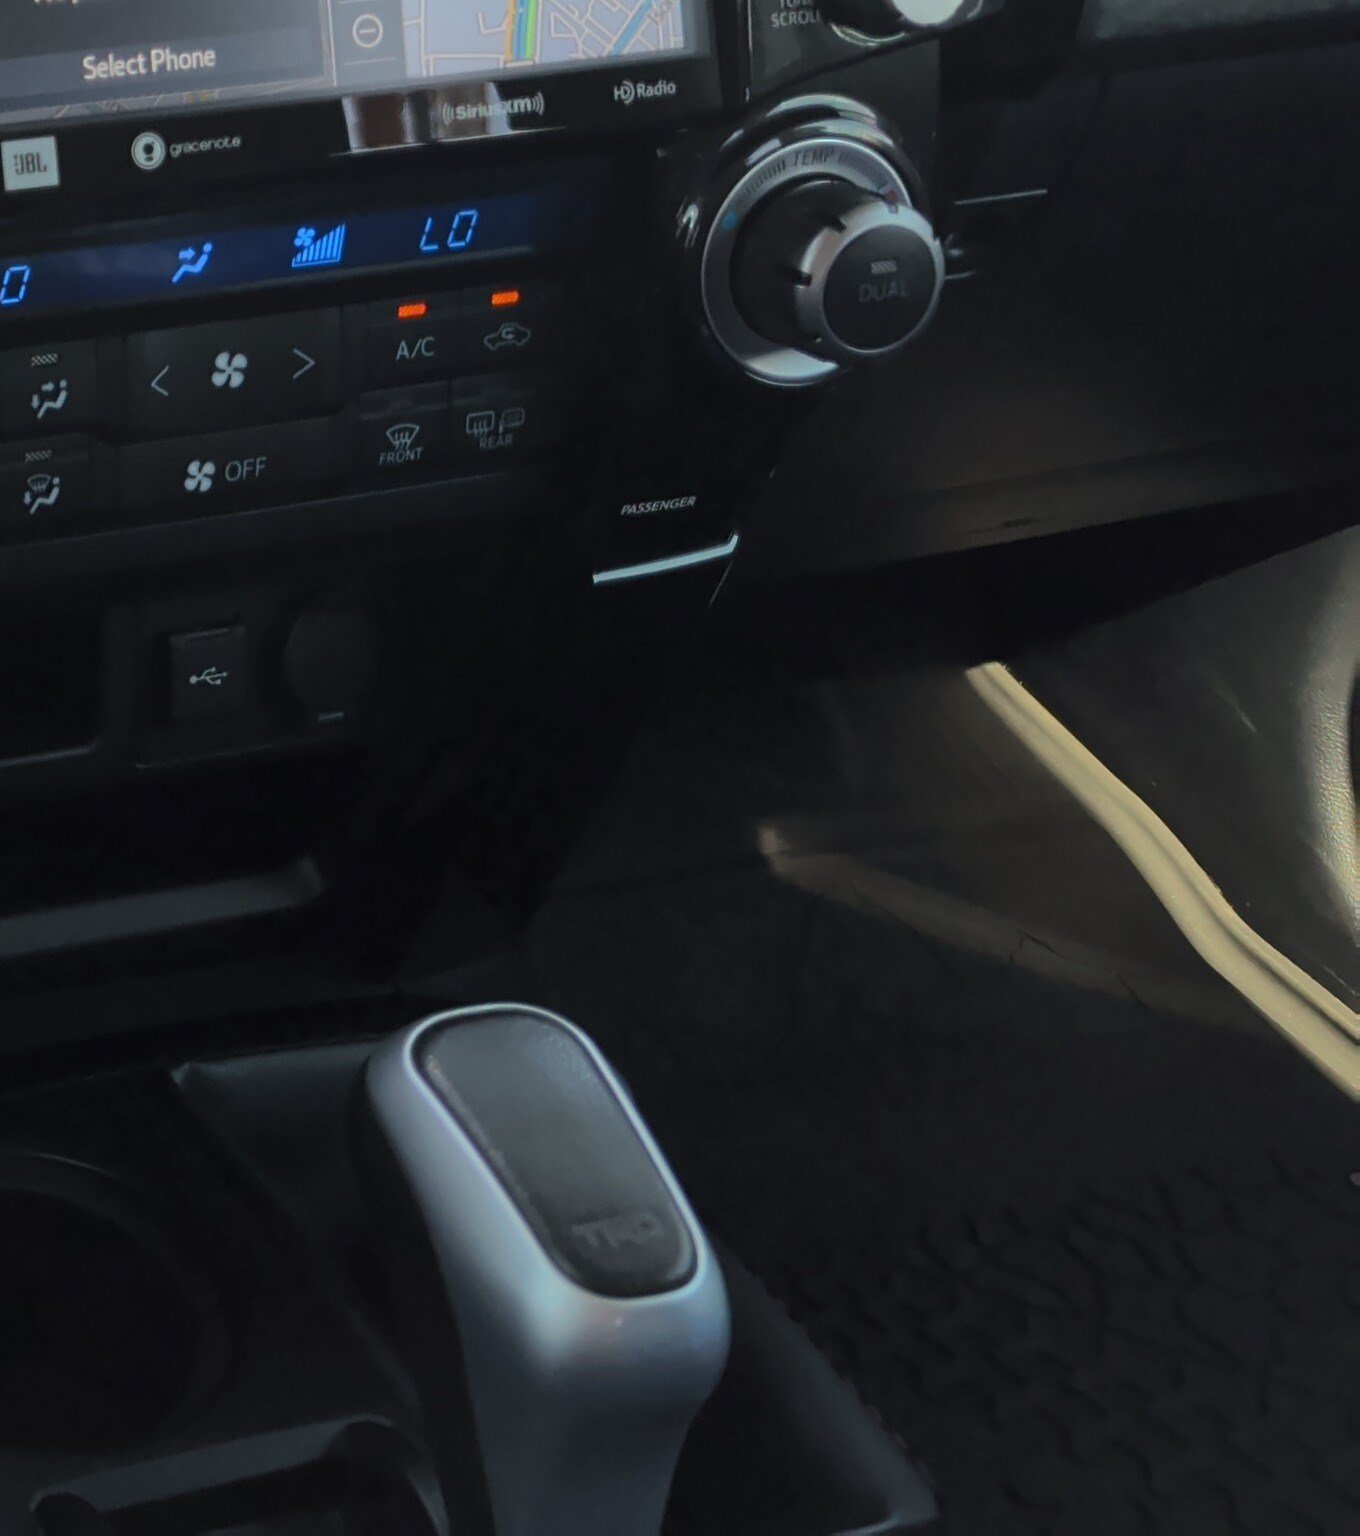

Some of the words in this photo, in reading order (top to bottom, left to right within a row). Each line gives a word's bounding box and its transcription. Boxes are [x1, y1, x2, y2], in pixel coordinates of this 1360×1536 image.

[82, 51, 147, 81] Select
[150, 46, 216, 74] Phone
[636, 81, 676, 98] Radio
[169, 133, 242, 157] gracenote
[14, 152, 48, 176] JBL
[858, 280, 910, 303] DUAL
[395, 336, 436, 361] A/C
[479, 432, 514, 450] REAR
[379, 446, 425, 464] FRONT
[224, 457, 268, 483] OFF
[620, 495, 697, 516] PASSENGER
